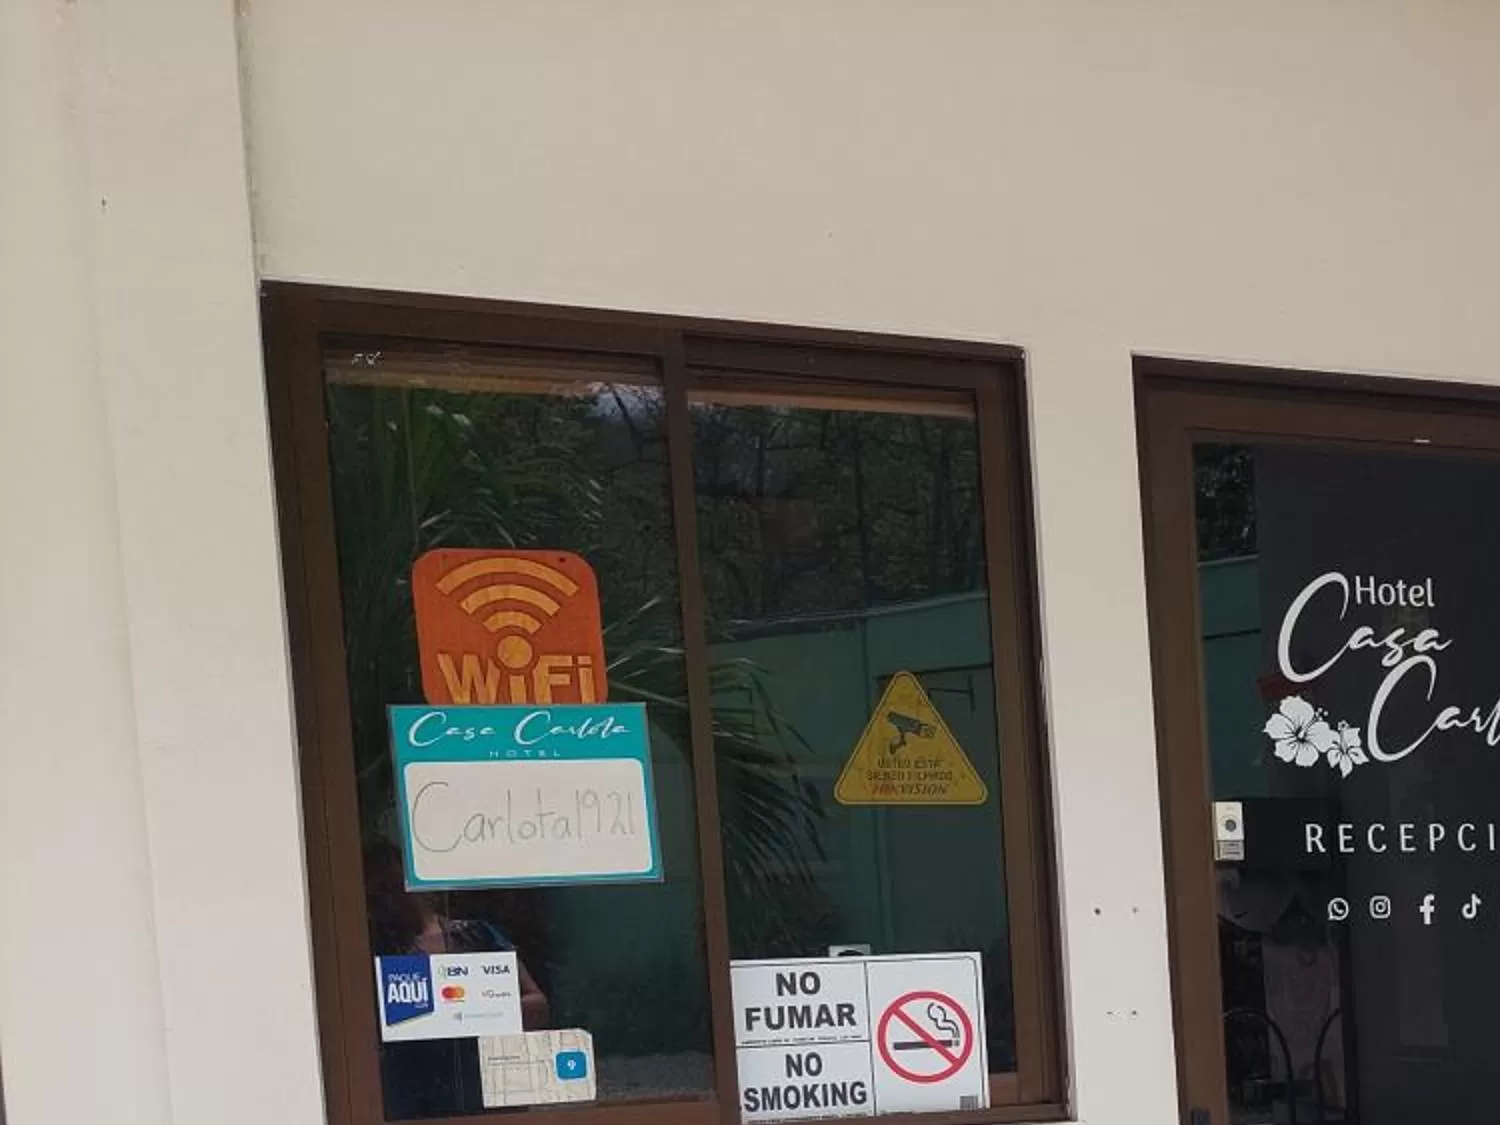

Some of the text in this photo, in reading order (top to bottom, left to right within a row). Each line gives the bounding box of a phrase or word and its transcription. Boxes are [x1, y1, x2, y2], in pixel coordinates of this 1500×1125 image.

[1355, 574, 1435, 607] Hotel
[1277, 571, 1452, 683] Casa
[437, 653, 595, 704] WiFi
[408, 710, 631, 746] Casa Carlota
[481, 964, 511, 975] VISA
[775, 971, 821, 996] NO
[745, 1003, 857, 1031] FUMAR
[785, 1052, 823, 1078] NO
[743, 1081, 867, 1112] SMOKING
